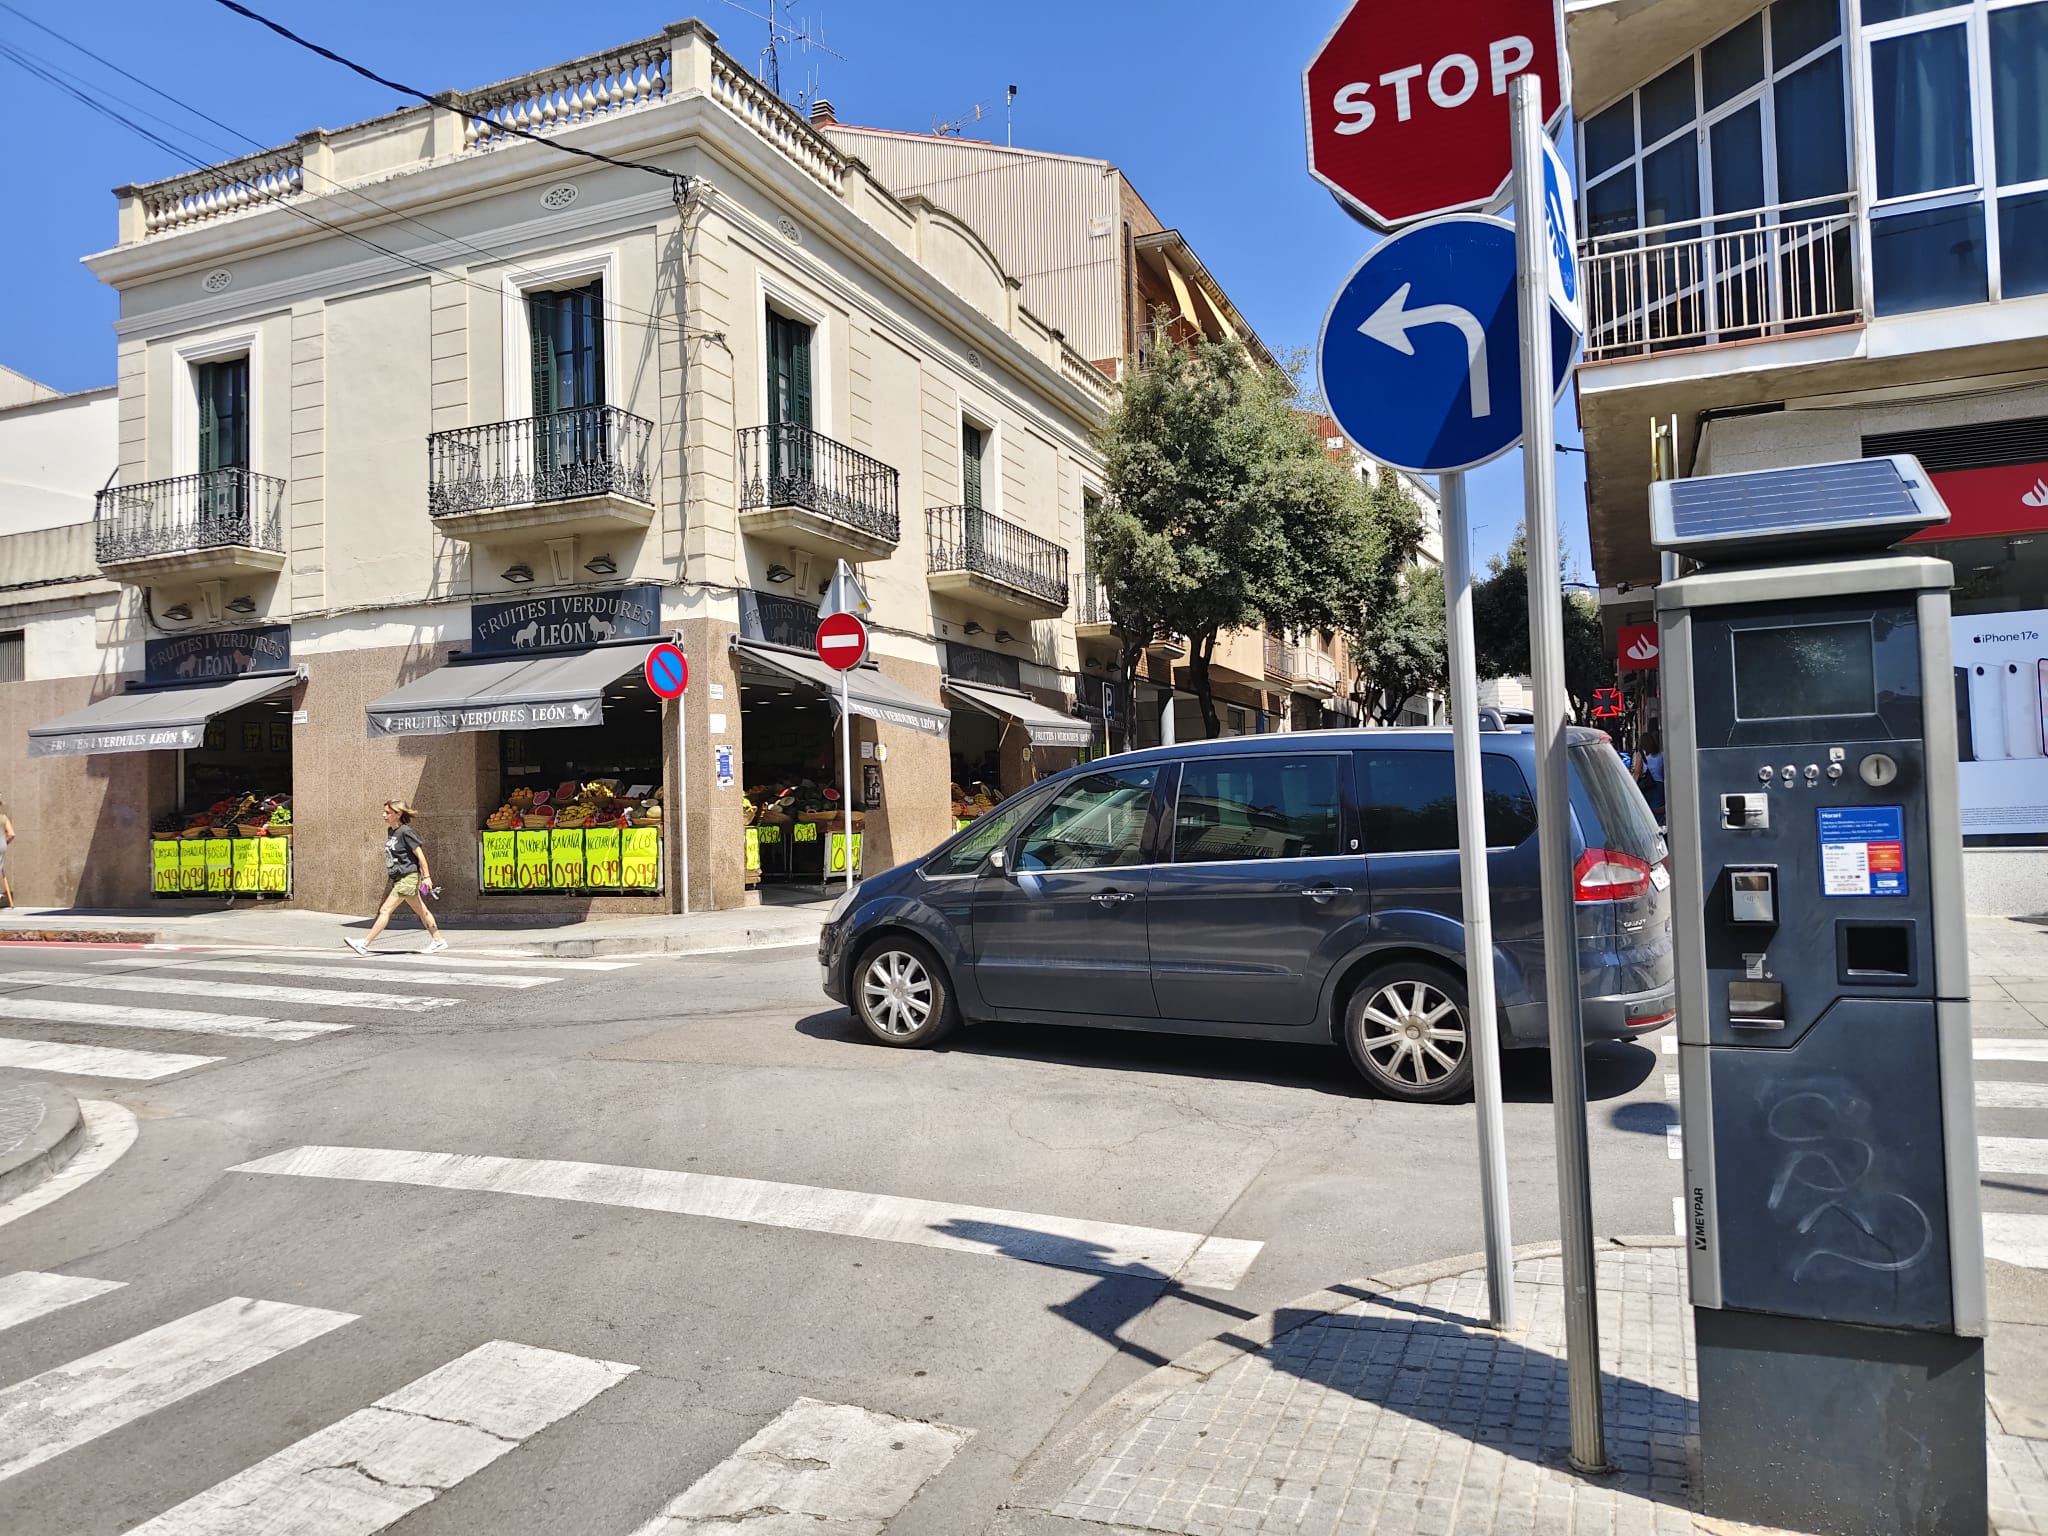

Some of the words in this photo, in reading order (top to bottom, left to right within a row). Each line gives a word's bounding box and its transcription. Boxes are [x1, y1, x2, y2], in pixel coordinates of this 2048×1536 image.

[1333, 35, 1534, 136] STOP
[477, 600, 547, 640] FRUITES
[551, 599, 557, 615] I
[561, 597, 654, 626] VERDURES
[540, 617, 587, 647] LEÓN
[1982, 633, 2020, 644] iPhone
[2021, 631, 2039, 641] 17e
[150, 635, 205, 671] FRUITES
[211, 633, 286, 661] VERDURES
[198, 651, 233, 677] LEÓN
[398, 714, 448, 730] FRUITES
[460, 709, 525, 726] VERDURES
[532, 705, 566, 721] LEÓN
[920, 716, 936, 731] LEÓN
[150, 730, 178, 745] LEÓN
[551, 833, 580, 850] BANANA
[554, 862, 582, 888] 0,99
[591, 860, 619, 888] 0,99
[624, 863, 656, 888] 0,99
[1694, 1187, 1705, 1237] MEYPAR
